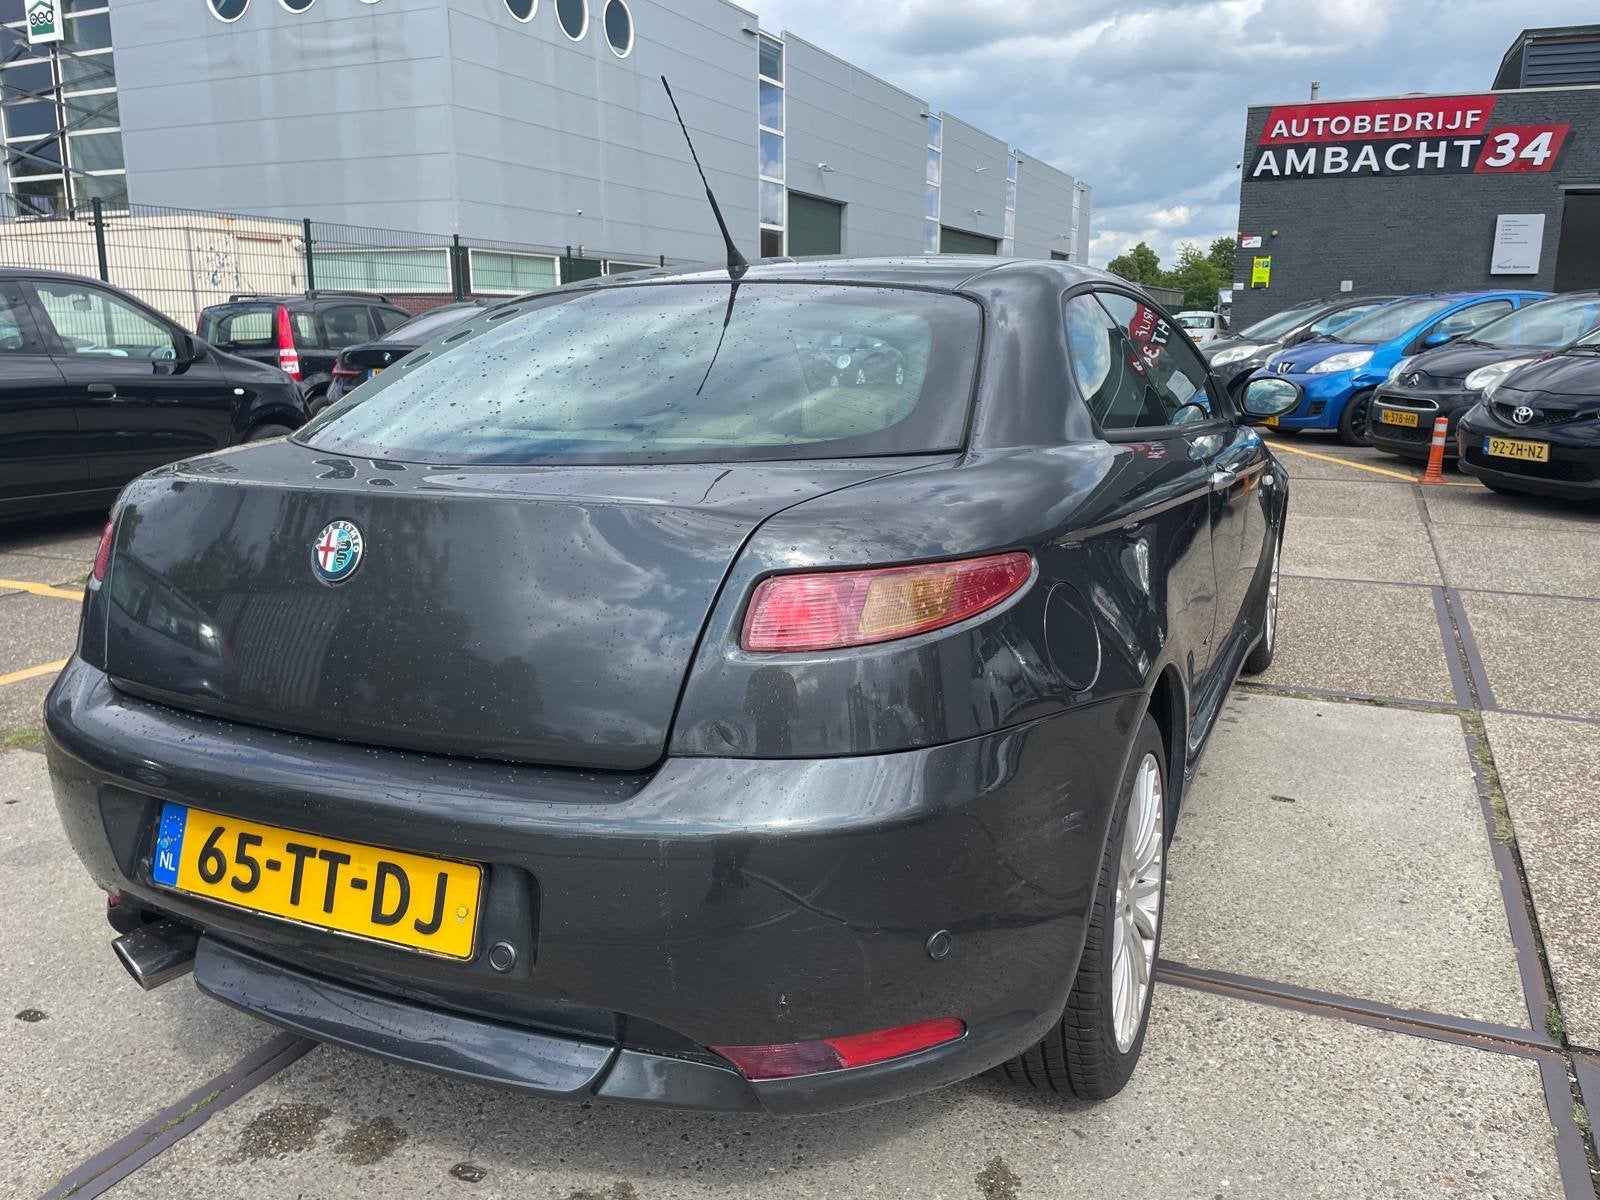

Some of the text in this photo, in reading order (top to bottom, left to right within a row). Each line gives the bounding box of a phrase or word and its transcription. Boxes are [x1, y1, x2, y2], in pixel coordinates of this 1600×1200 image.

[1270, 110, 1482, 138] AUTOBEDRIJF
[1252, 132, 1553, 177] AMBACHT 34
[1492, 440, 1544, 459] 92-ZH-NZ
[159, 850, 175, 871] NL
[198, 825, 450, 935] 65-TT-DJ
